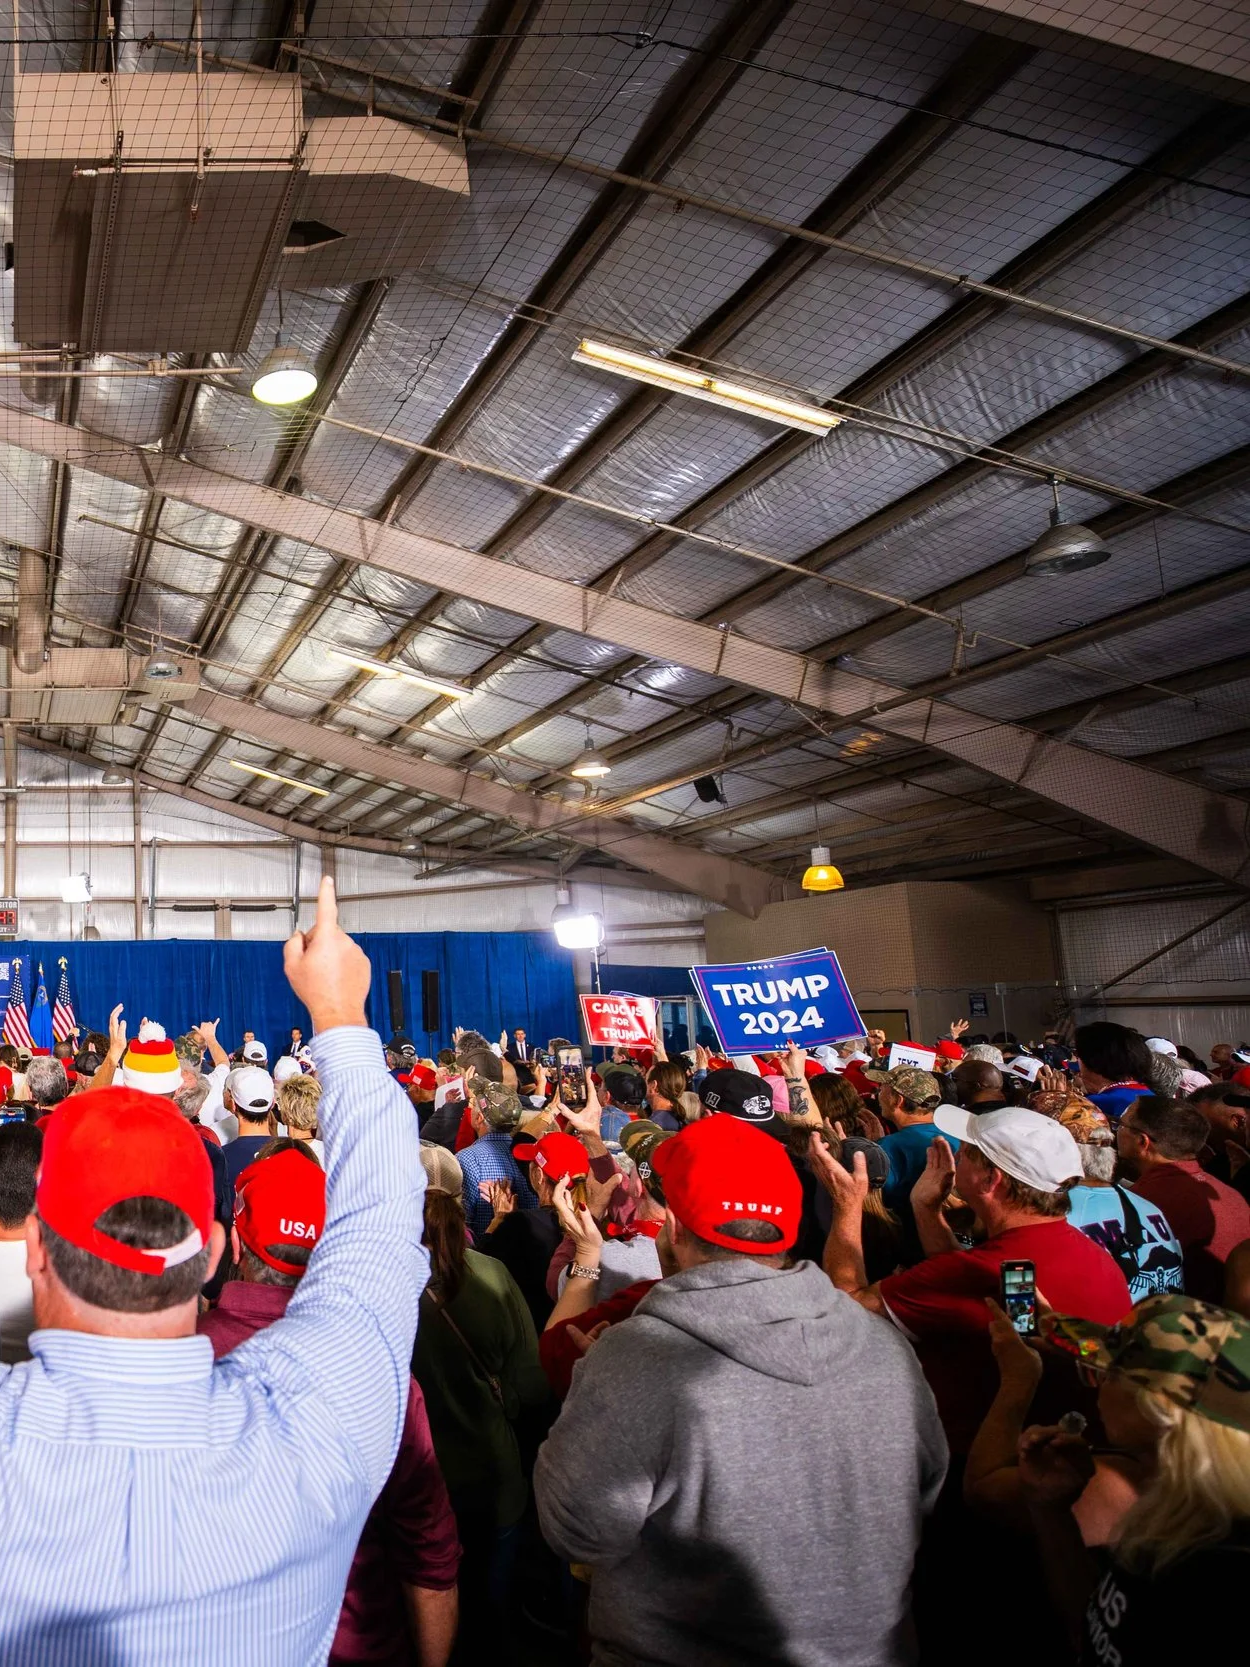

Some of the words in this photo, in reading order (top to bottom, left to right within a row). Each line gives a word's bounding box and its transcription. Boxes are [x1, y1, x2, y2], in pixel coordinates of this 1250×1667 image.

[712, 974, 830, 1006] TRUMP
[592, 1002, 644, 1017] CAUCUS
[611, 1017, 629, 1026] FOR
[738, 1006, 825, 1035] 2024
[601, 1027, 642, 1041] TRUMP
[722, 1202, 783, 1215] TRUMP
[280, 1218, 316, 1240] USA
[1098, 1571, 1127, 1628] US
